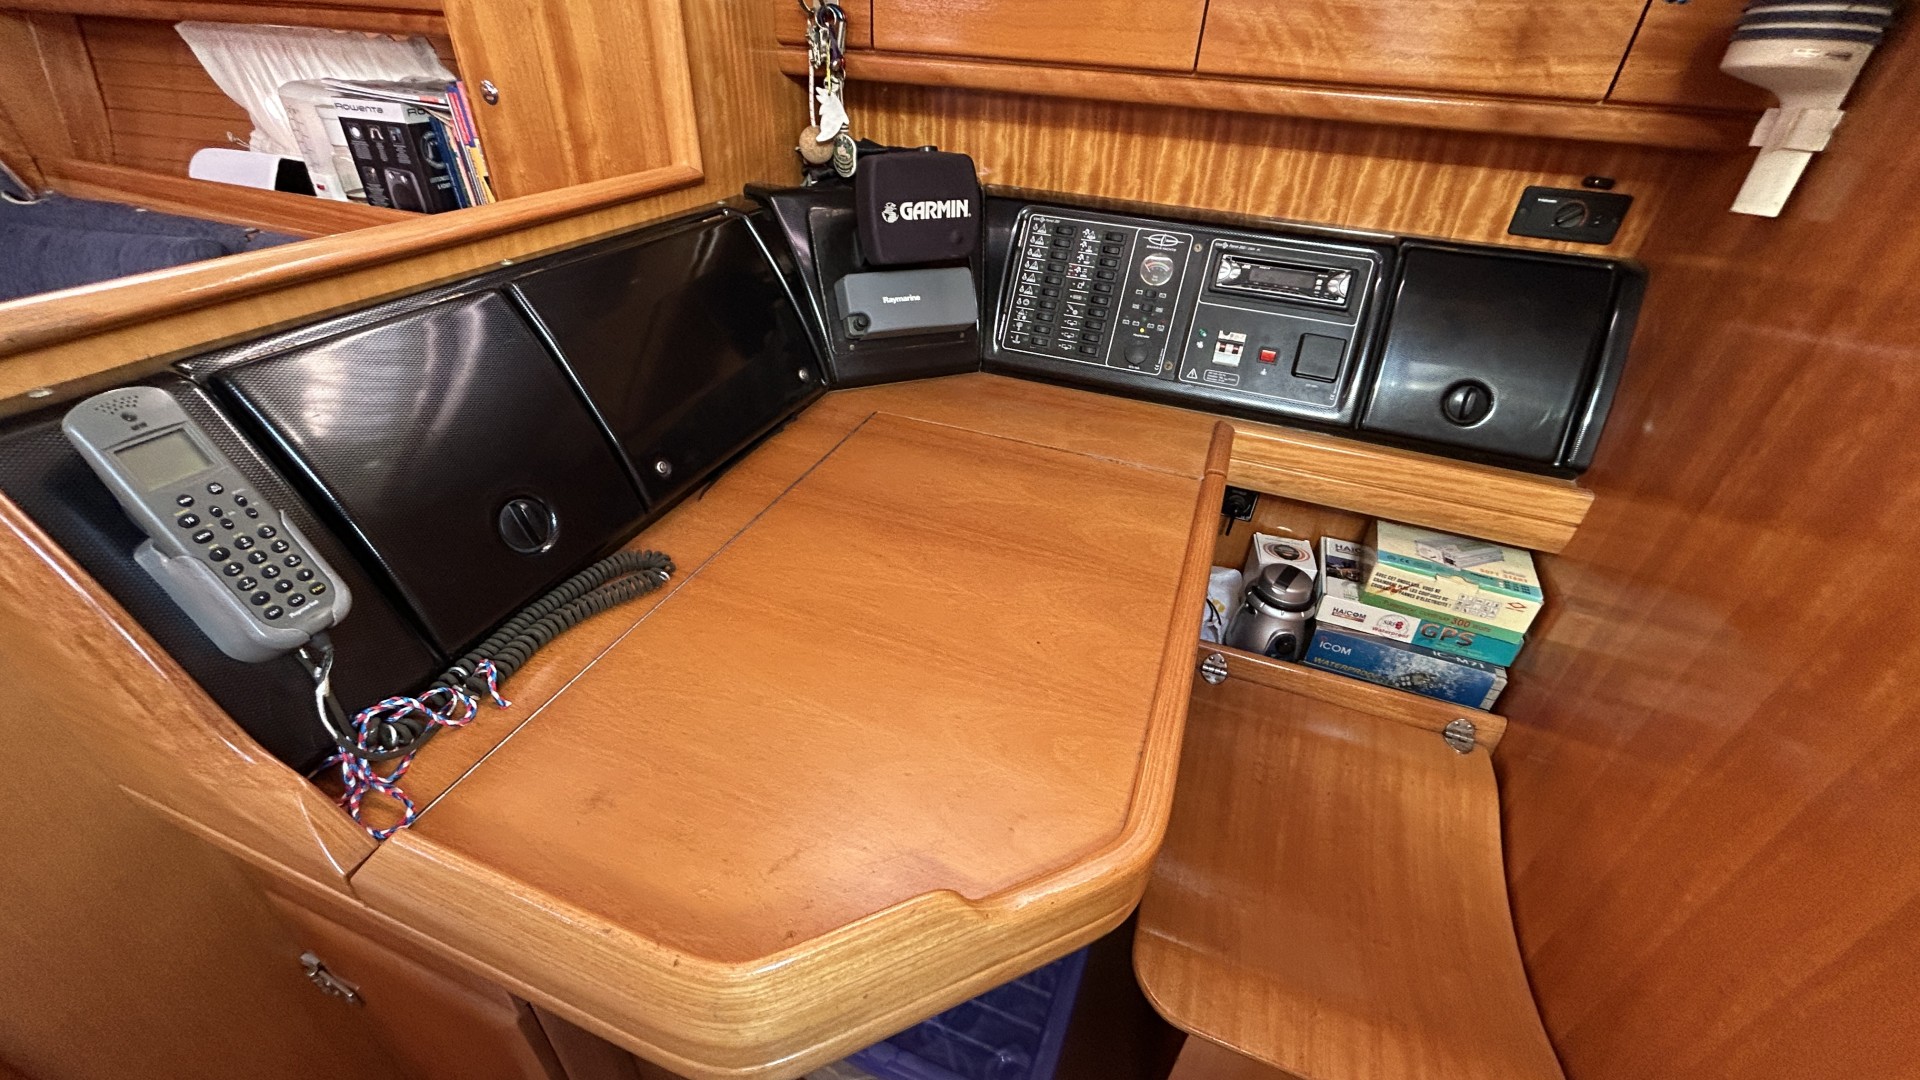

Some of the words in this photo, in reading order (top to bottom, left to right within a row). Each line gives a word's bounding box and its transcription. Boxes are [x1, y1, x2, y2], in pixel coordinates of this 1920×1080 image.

[900, 199, 969, 220] GARMIN
[882, 294, 921, 304] Raymarine
[1452, 617, 1471, 628] 300
[1420, 622, 1476, 646] GPS
